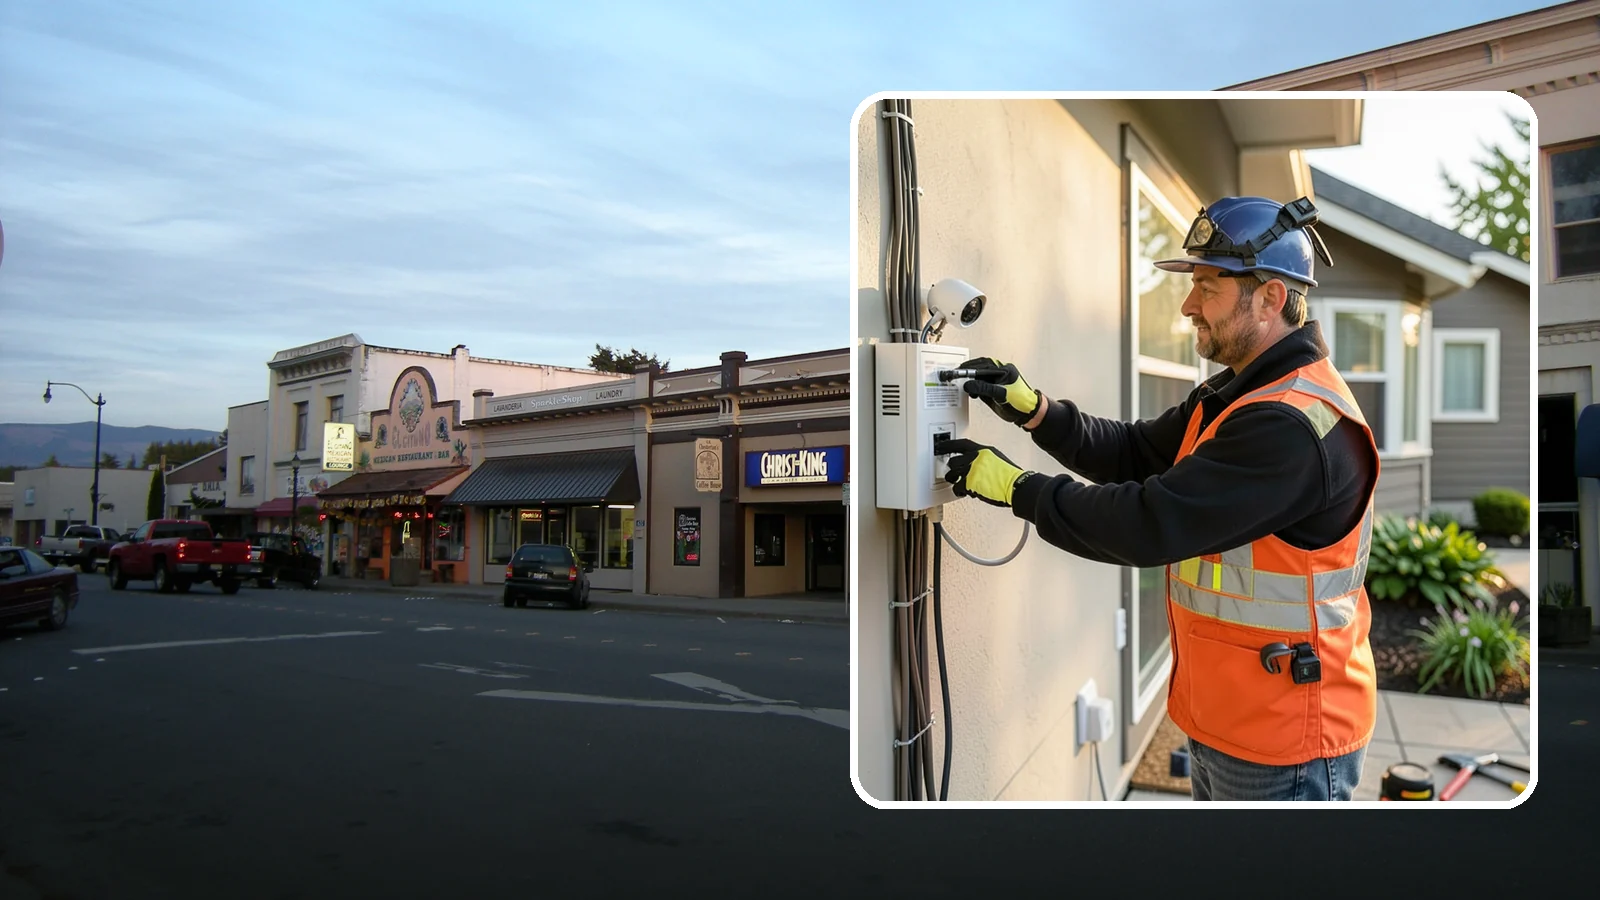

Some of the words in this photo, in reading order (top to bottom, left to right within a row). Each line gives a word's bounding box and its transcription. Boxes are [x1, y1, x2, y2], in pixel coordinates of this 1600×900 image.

[595, 389, 623, 400] LAUNDRY
[493, 402, 523, 412] LAVANDERIA
[373, 455, 396, 464] MEXICAN
[397, 451, 433, 462] RESTAURANT
[438, 450, 450, 459] BAR
[760, 452, 797, 478] CHRIST
[799, 450, 827, 476] KING
